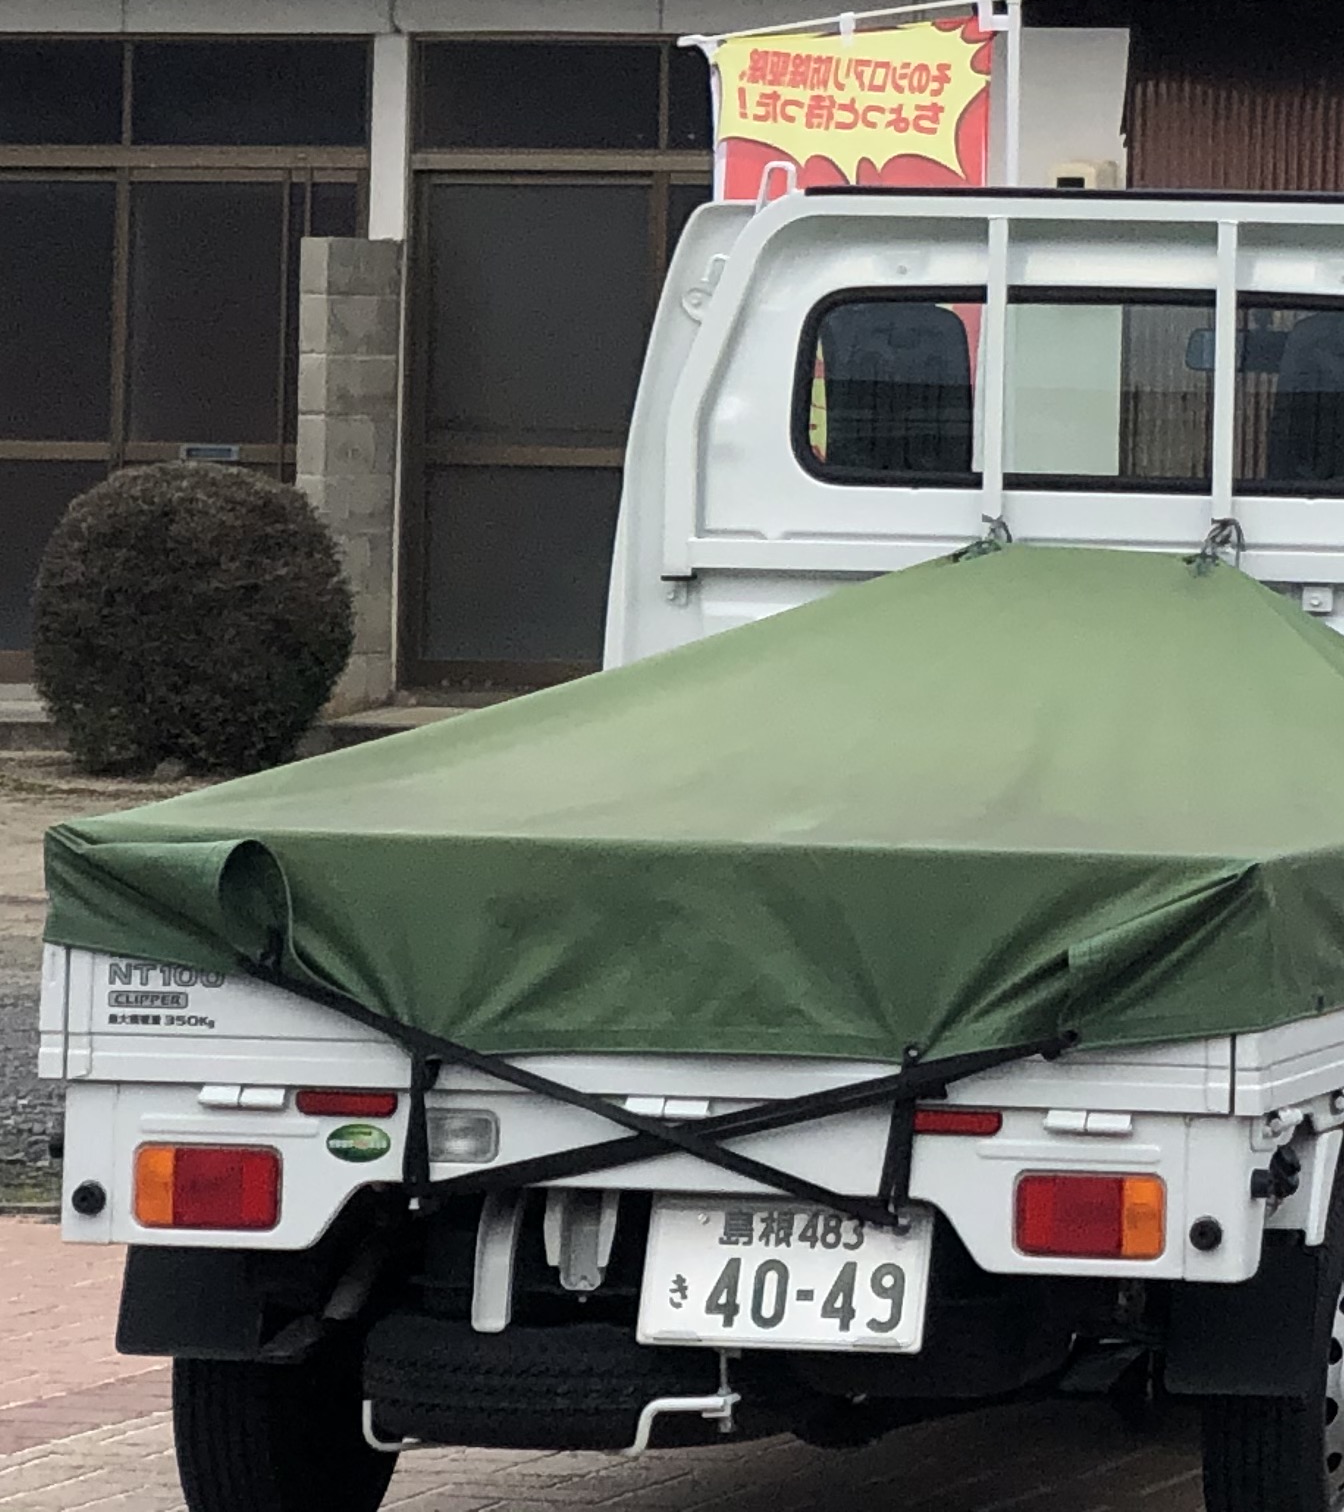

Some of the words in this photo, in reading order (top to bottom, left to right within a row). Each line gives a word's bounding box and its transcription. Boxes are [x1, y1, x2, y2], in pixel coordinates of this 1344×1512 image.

[107, 961, 226, 988] NT100
[112, 993, 183, 1007] CLIPPER
[668, 1274, 689, 1309] き
[704, 1256, 906, 1334] 40-49
